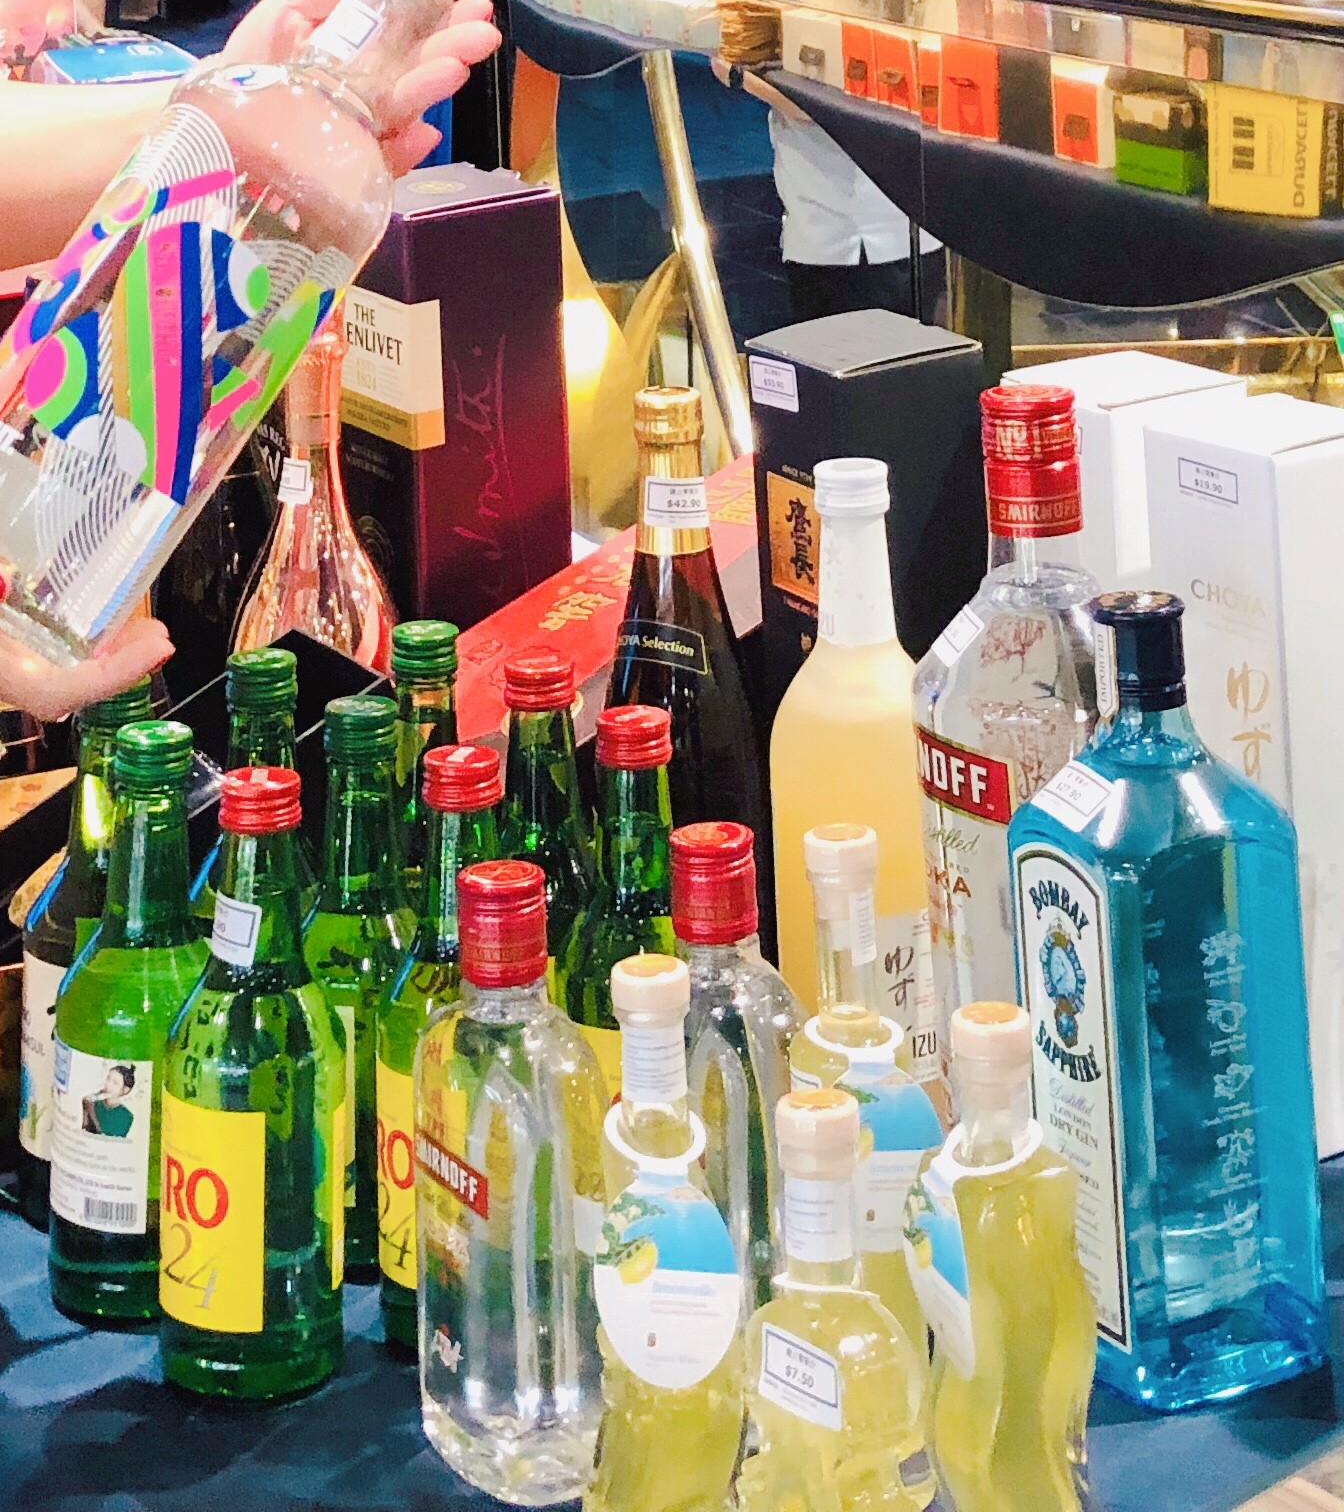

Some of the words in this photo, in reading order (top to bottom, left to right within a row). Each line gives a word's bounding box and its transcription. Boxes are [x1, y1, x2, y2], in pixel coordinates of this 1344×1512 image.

[354, 303, 376, 327] THE
[1191, 579, 1266, 617] CHOYA
[643, 635, 695, 657] Selection
[1227, 659, 1272, 781] ゆず
[1029, 879, 1090, 940] BOMBAY
[884, 945, 915, 1011] ゆず
[1036, 1020, 1102, 1082] SAPPHIRE
[1049, 1113, 1073, 1136] DRY
[163, 1223, 228, 1310] 24
[785, 1365, 814, 1388] $7.50
